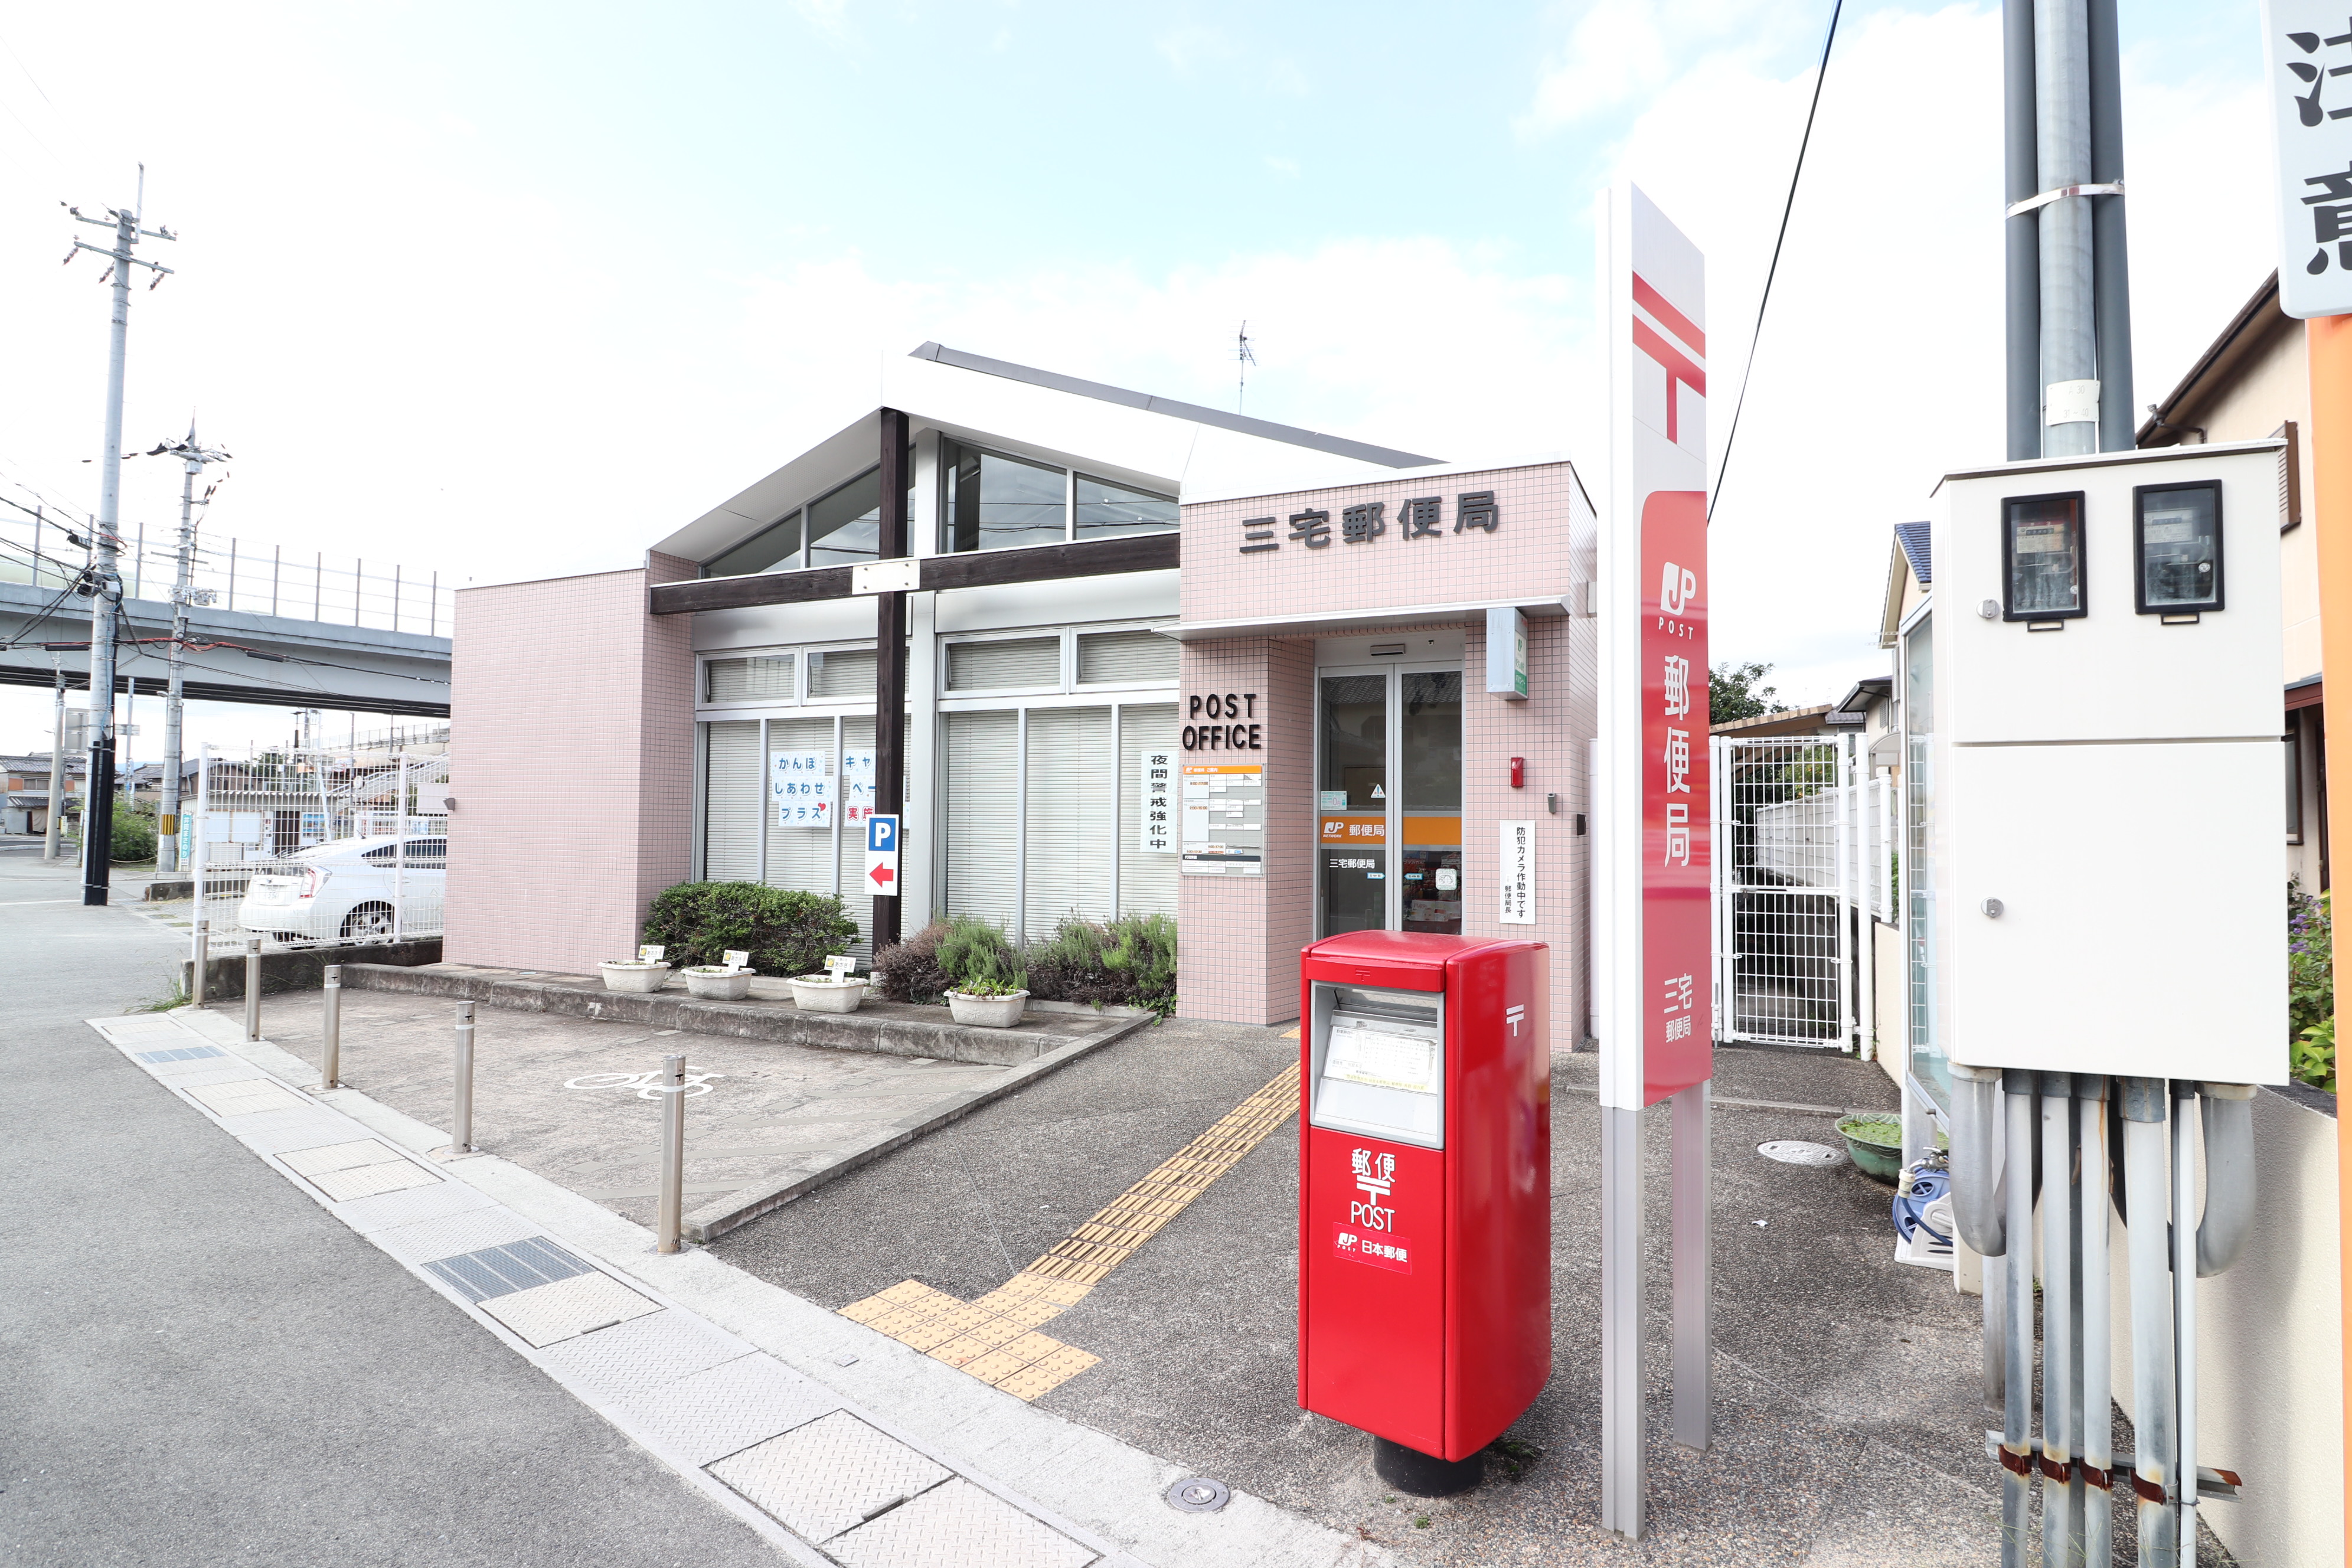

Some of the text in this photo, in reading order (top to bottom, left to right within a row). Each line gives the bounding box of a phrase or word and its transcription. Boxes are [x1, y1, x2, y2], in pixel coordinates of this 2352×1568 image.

[1240, 491, 1498, 553] 三宅郵便局
[1660, 561, 1696, 616] JP
[1658, 616, 1694, 640] POST
[1190, 694, 1256, 720] POST
[1182, 724, 1262, 750] OFFICE
[779, 757, 816, 770] かんぽ
[1664, 654, 1690, 867] 郵便局
[775, 782, 825, 795] しあわせ
[1149, 754, 1168, 849] 夜間警戒強化中
[782, 807, 821, 819] プラス
[875, 822, 891, 847] P
[1349, 824, 1385, 837] 郵便局
[1329, 858, 1376, 869] 三宅郵便局
[1516, 827, 1526, 919] 防犯カメラ作動中です
[1664, 973, 1693, 1014] 三宅
[1666, 1015, 1691, 1043] 郵便局
[1351, 1148, 1396, 1182] 郵便
[1351, 1200, 1395, 1233] POST
[1362, 1240, 1407, 1263] 日本郵便
